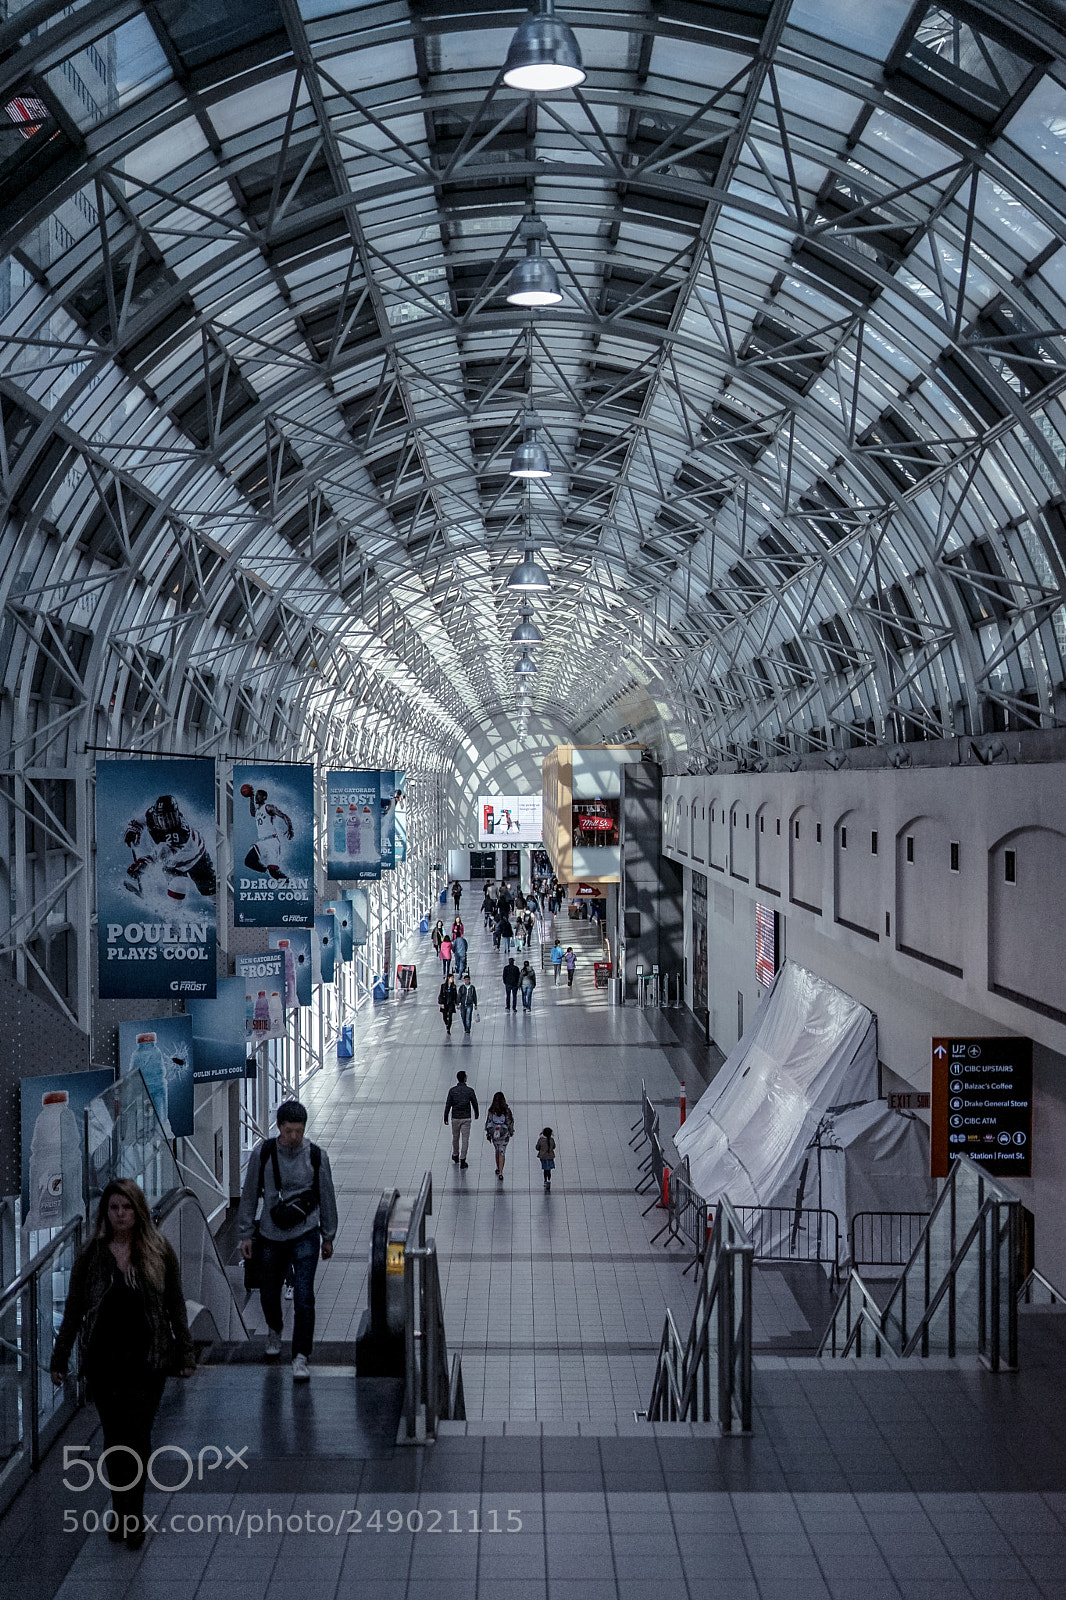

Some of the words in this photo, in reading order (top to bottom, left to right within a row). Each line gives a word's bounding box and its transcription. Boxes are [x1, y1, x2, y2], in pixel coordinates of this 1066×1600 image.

[330, 794, 376, 805] FROST
[165, 833, 180, 843] 29
[240, 892, 274, 901] PLAYS
[278, 892, 309, 901] COOL
[107, 923, 208, 943] POULIN
[107, 948, 158, 960] PLAYS
[163, 947, 208, 960] COOL
[240, 962, 281, 978] FROST
[170, 981, 179, 991] G
[952, 1044, 966, 1054] UP
[212, 1068, 228, 1076] PLAYS
[228, 1066, 243, 1074] COOL
[890, 1094, 911, 1108] EXIT
[970, 1152, 993, 1160] Station
[997, 1152, 1015, 1160] Front
[1016, 1152, 1025, 1160] St.
